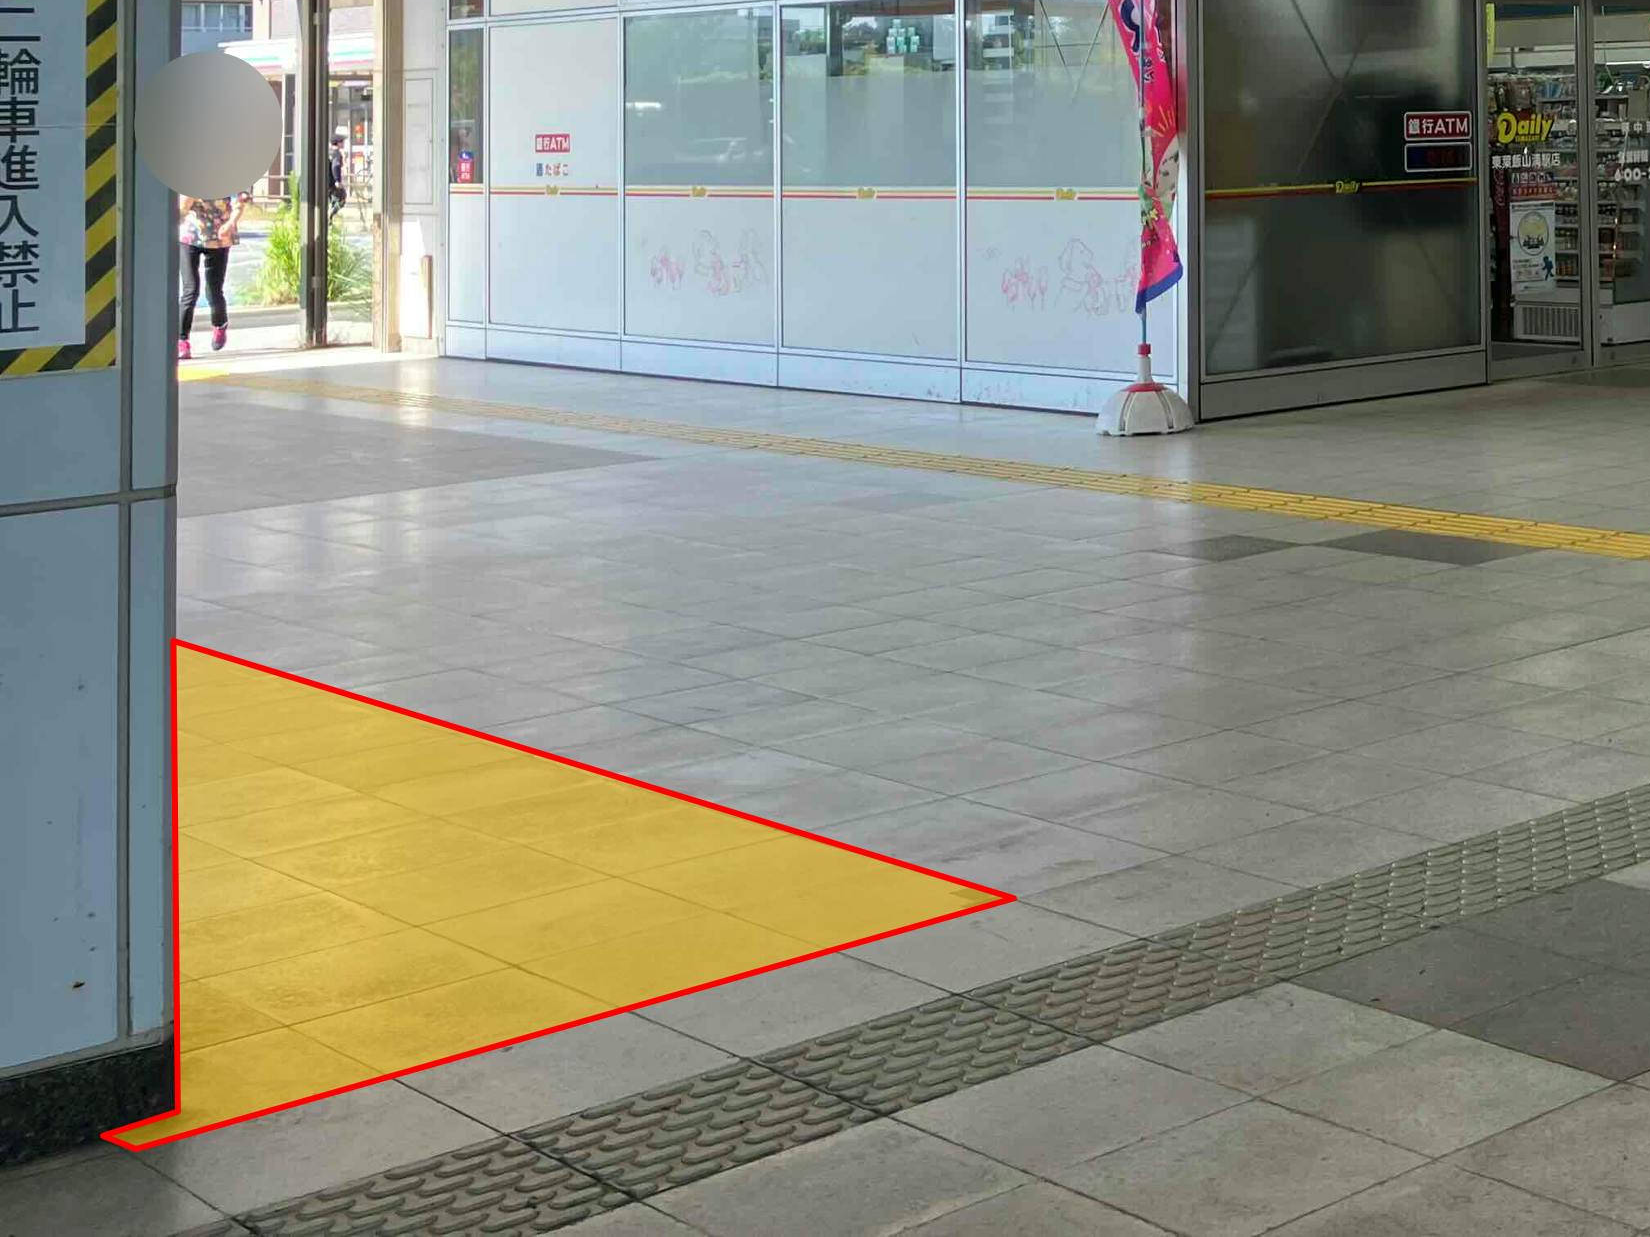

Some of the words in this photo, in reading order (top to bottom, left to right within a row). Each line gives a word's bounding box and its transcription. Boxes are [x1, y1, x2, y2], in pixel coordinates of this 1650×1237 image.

[1408, 117, 1468, 135] 銀行ATM
[1497, 112, 1553, 144] Daily
[536, 137, 569, 150] 銀行ATM
[0, 5, 41, 335] 二輪車進入禁止
